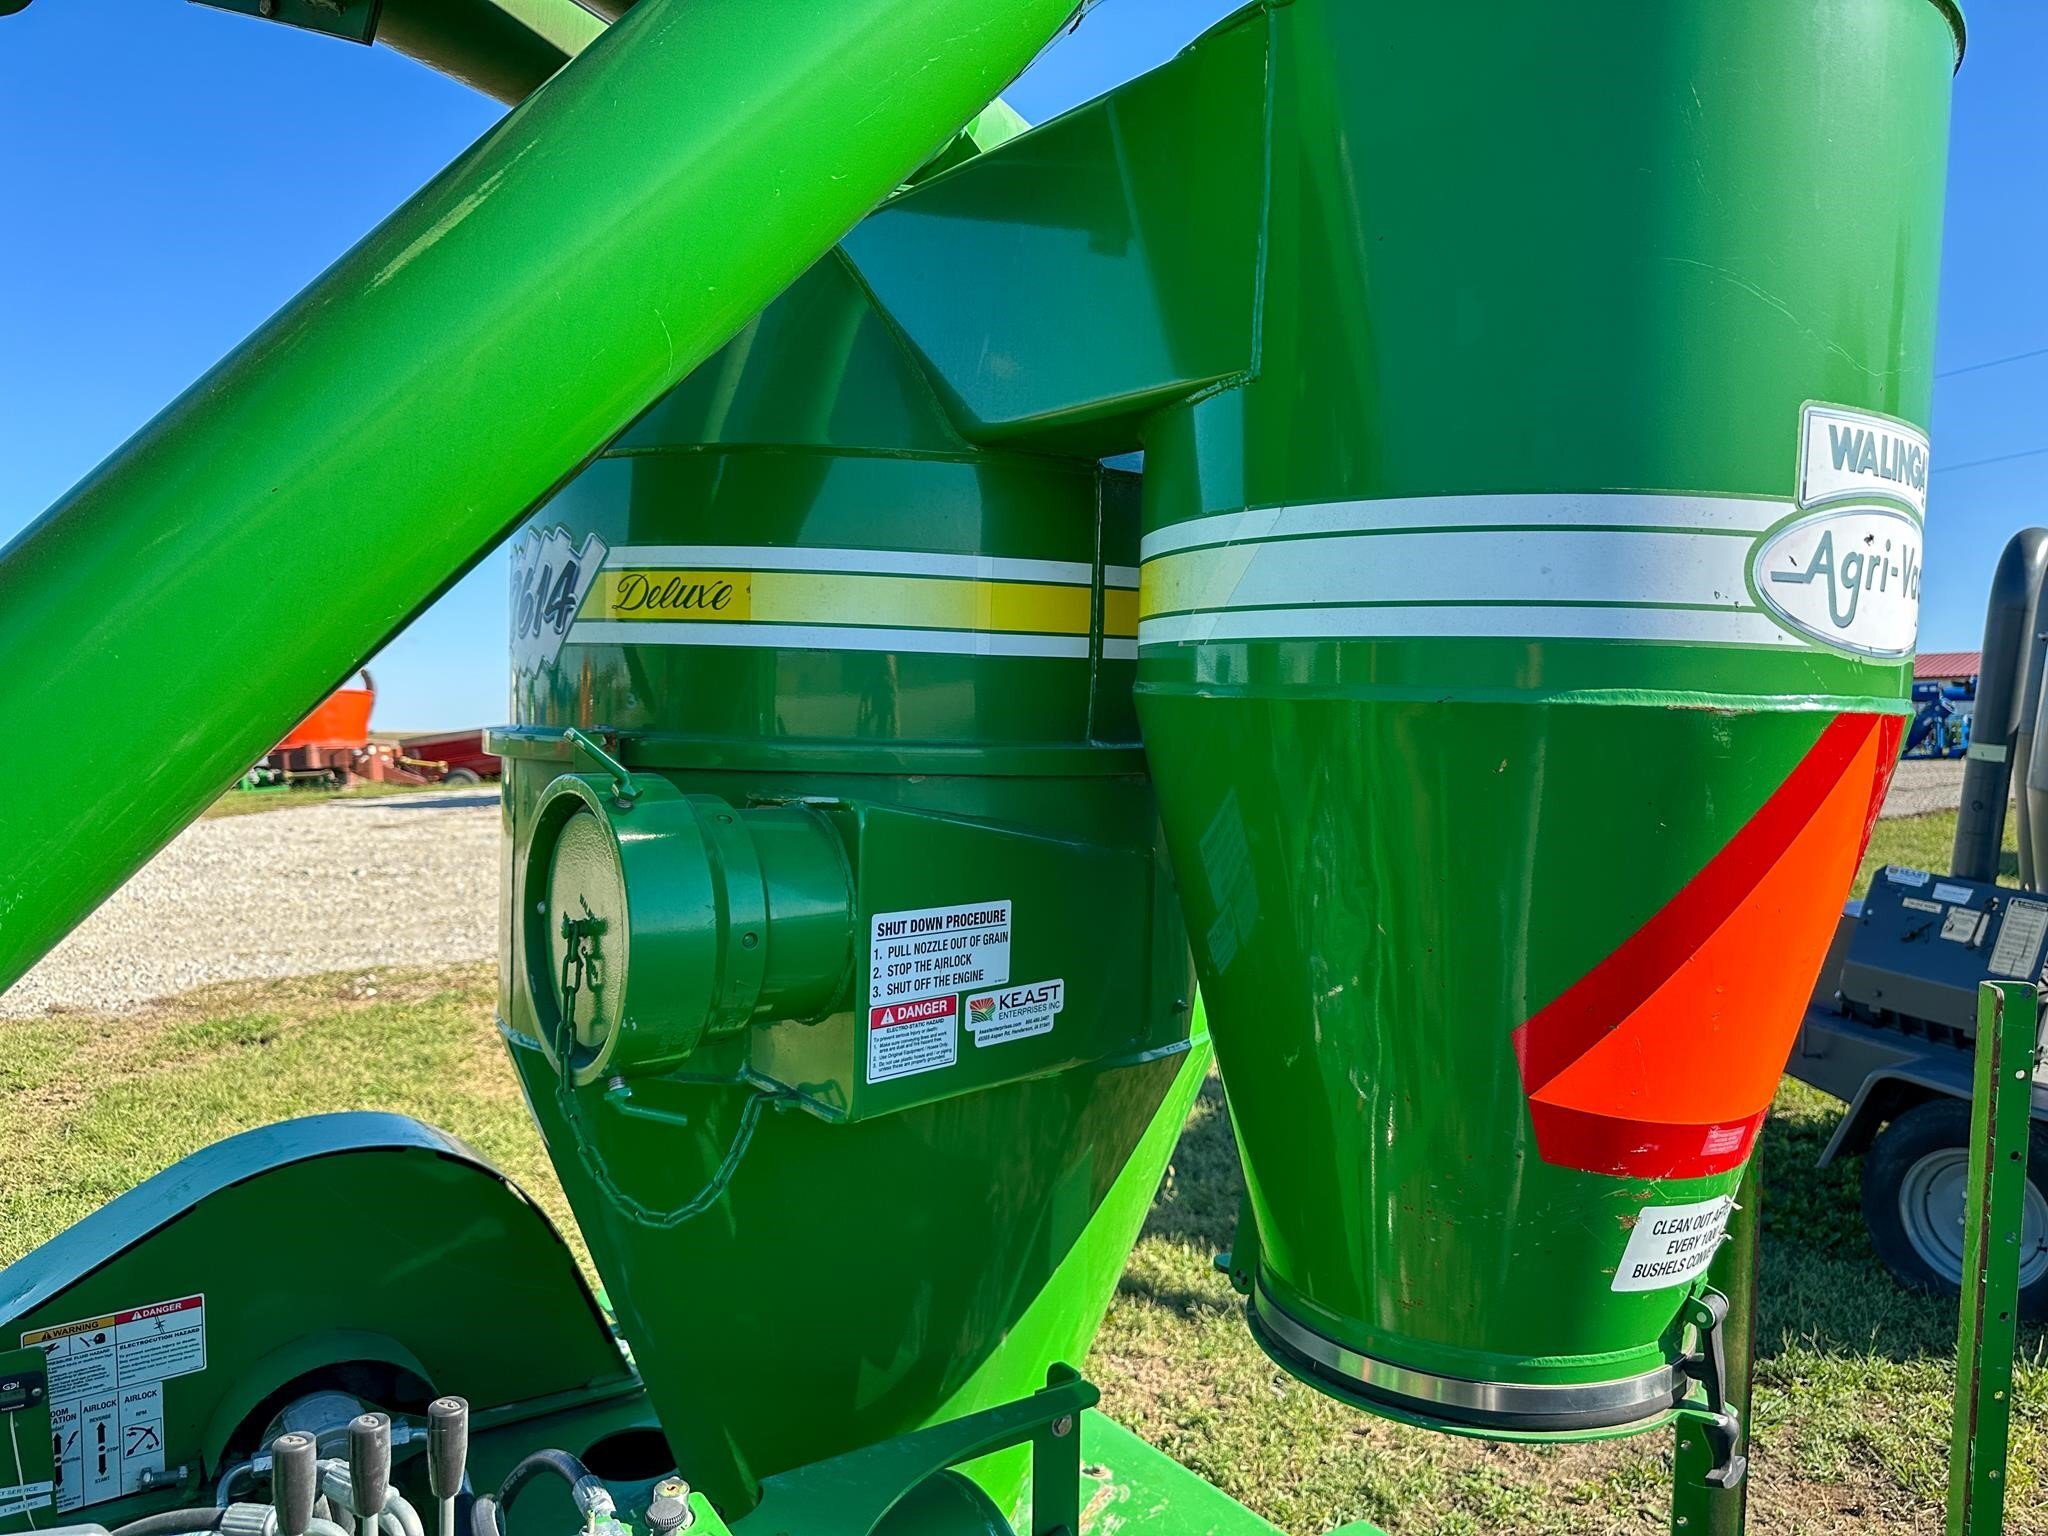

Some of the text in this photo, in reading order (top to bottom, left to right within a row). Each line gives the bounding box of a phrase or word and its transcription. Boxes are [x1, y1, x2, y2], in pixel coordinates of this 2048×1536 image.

[1770, 530, 1922, 628] Agri-Va
[612, 574, 732, 610] Deluxe
[878, 909, 1006, 937] SHUT DOWN PROCEDURE
[874, 931, 1009, 960] 1. PULL NOZZLE OUT OF GRAIN
[873, 953, 972, 979] 2. STOP THE AIRLOCK
[872, 986, 881, 998] 3.
[887, 982, 911, 996] SHUT
[914, 978, 931, 991] OFF
[933, 974, 950, 988] THE
[952, 969, 984, 985] ENGINE
[1000, 984, 1060, 1010] KEAST
[898, 1000, 947, 1020] DANGER
[999, 1004, 1046, 1020] ENTERPRISES
[1048, 1001, 1060, 1010] INC
[1653, 1217, 1693, 1235] CLEAN
[1693, 1212, 1713, 1230] OUT
[1666, 1234, 1702, 1255] EVERY
[1632, 1258, 1686, 1279] BUSHELS
[143, 1302, 182, 1317] DANGER
[53, 1322, 99, 1337] WARNING
[119, 1327, 199, 1350] ELECTROCUTION HAZARD
[83, 1400, 117, 1413] AIRLOCK
[125, 1390, 157, 1403] AIRLOCK
[51, 1408, 68, 1417] OOM
[89, 1414, 111, 1423] REVERSE
